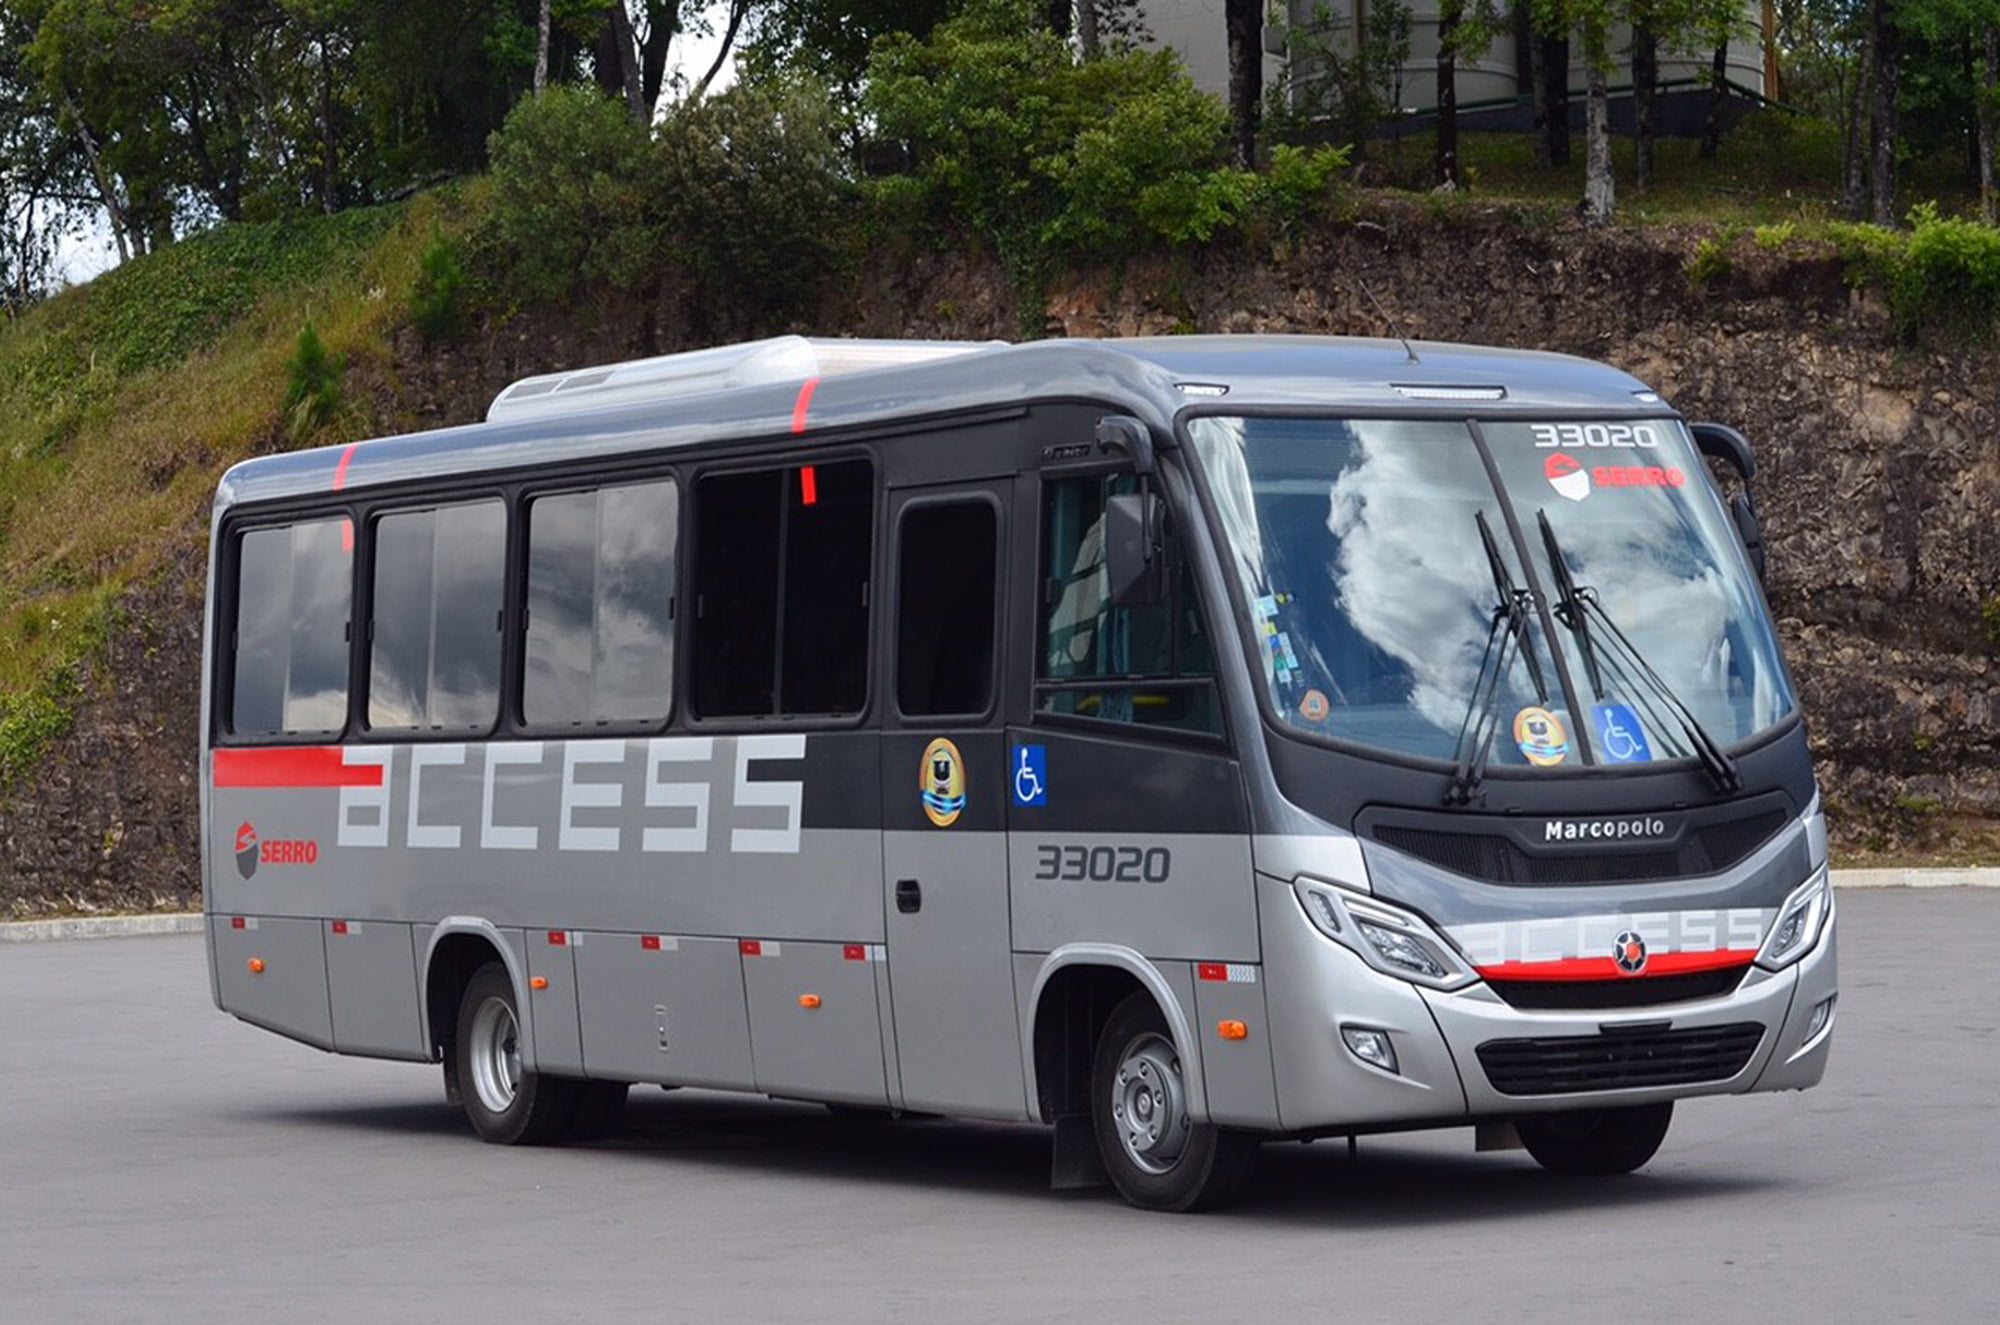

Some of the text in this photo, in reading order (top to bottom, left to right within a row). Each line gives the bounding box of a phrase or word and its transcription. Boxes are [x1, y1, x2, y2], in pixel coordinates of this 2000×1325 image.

[1531, 424, 1658, 449] 33020
[1592, 465, 1686, 488] SERRO
[1545, 817, 1664, 841] Marcopolo
[260, 840, 318, 865] SERRO
[1035, 845, 1171, 883] 33020
